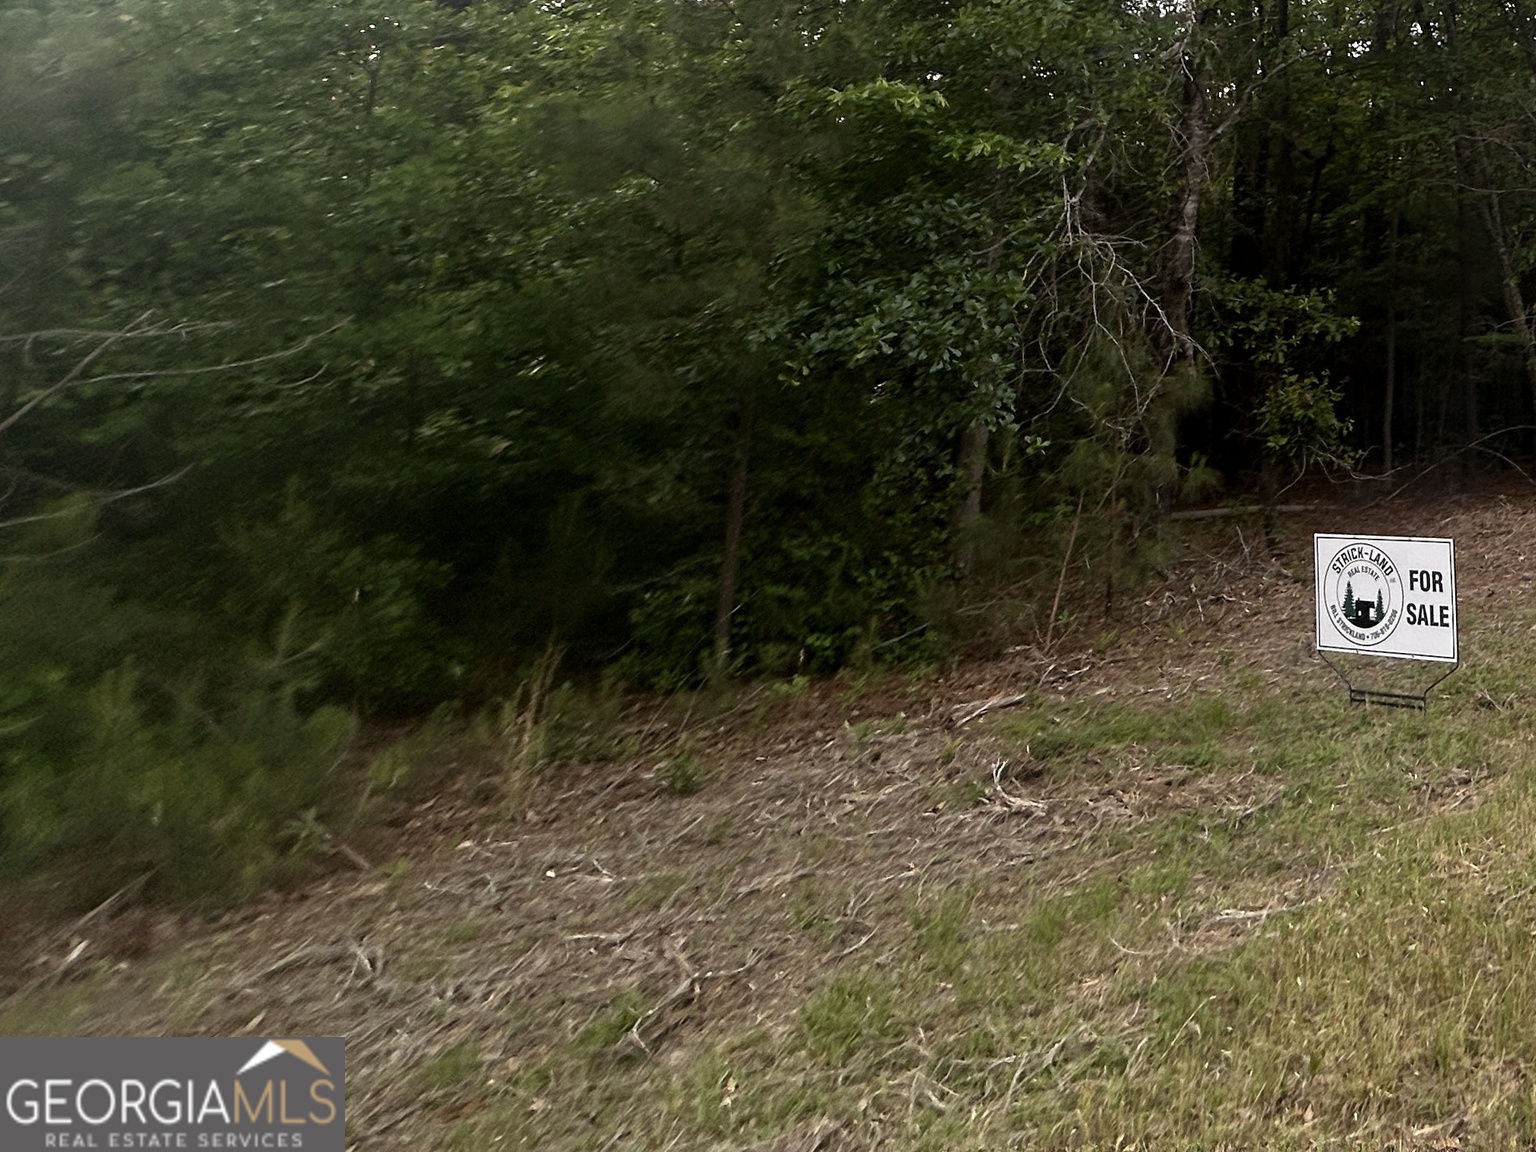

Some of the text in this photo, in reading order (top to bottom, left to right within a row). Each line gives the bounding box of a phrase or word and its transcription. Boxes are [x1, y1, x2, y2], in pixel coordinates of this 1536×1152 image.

[1332, 547, 1394, 576] STRICK-LAND
[1347, 565, 1380, 582] REAL ESTATE
[1409, 569, 1444, 593] FOR
[1406, 603, 1450, 628] SALE
